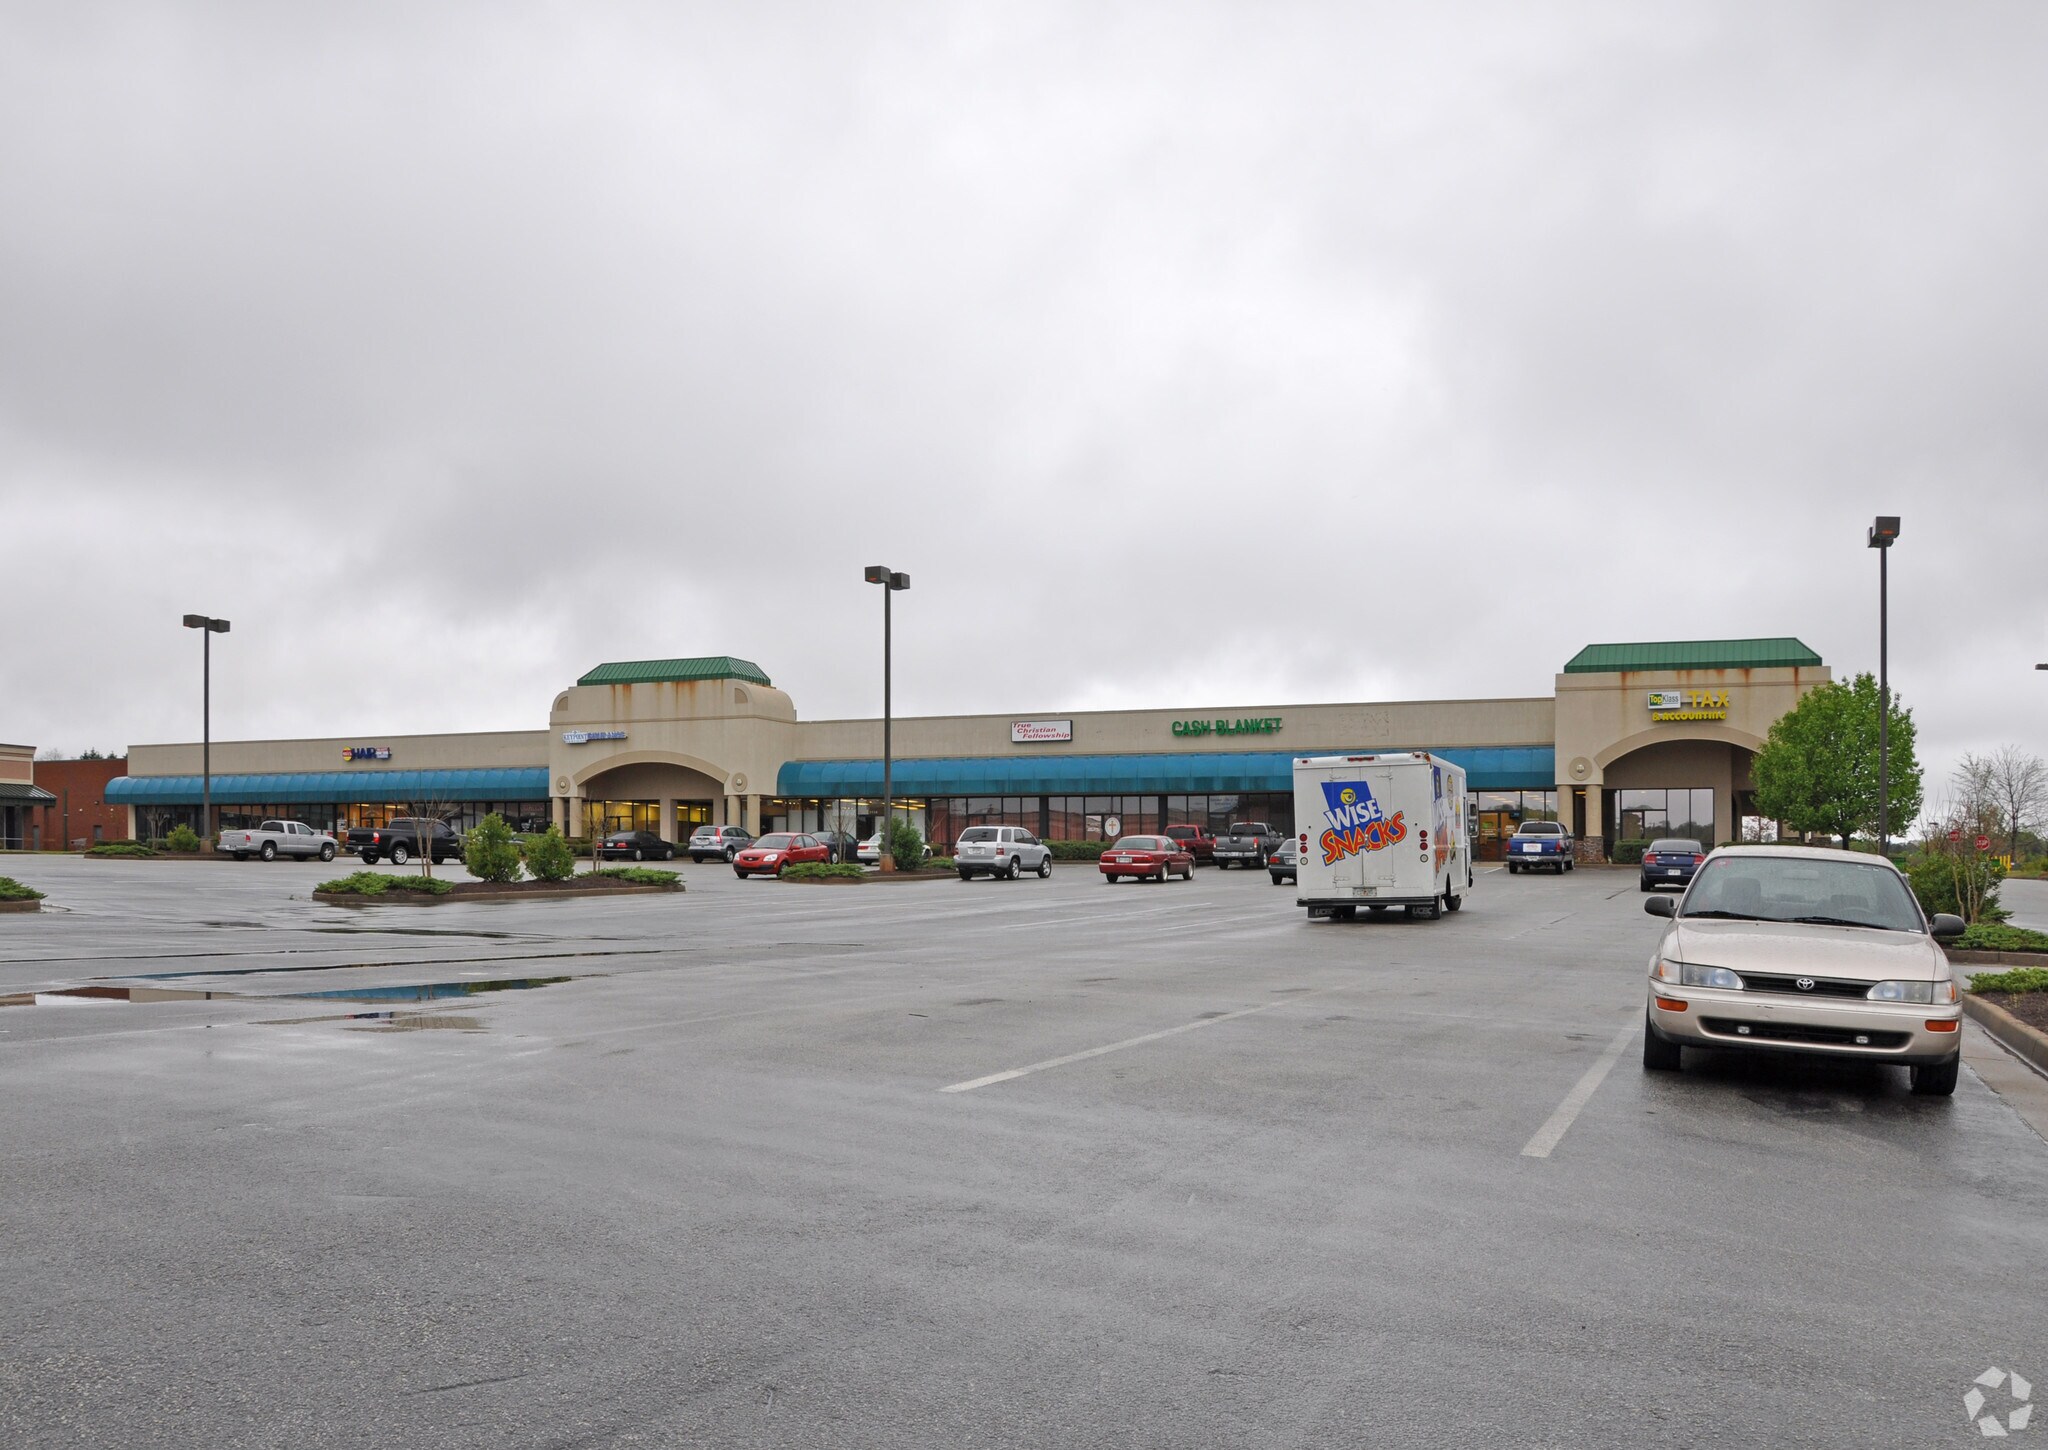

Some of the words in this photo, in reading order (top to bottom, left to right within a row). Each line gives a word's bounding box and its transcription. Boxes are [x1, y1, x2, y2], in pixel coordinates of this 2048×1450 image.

[1688, 690, 1729, 708] TAX
[1662, 711, 1727, 720] ACCOUNTING
[1171, 720, 1211, 737] CASH
[1215, 717, 1282, 736] BLANKET
[1324, 799, 1382, 830] WISE
[1319, 810, 1407, 866] SNACKS
